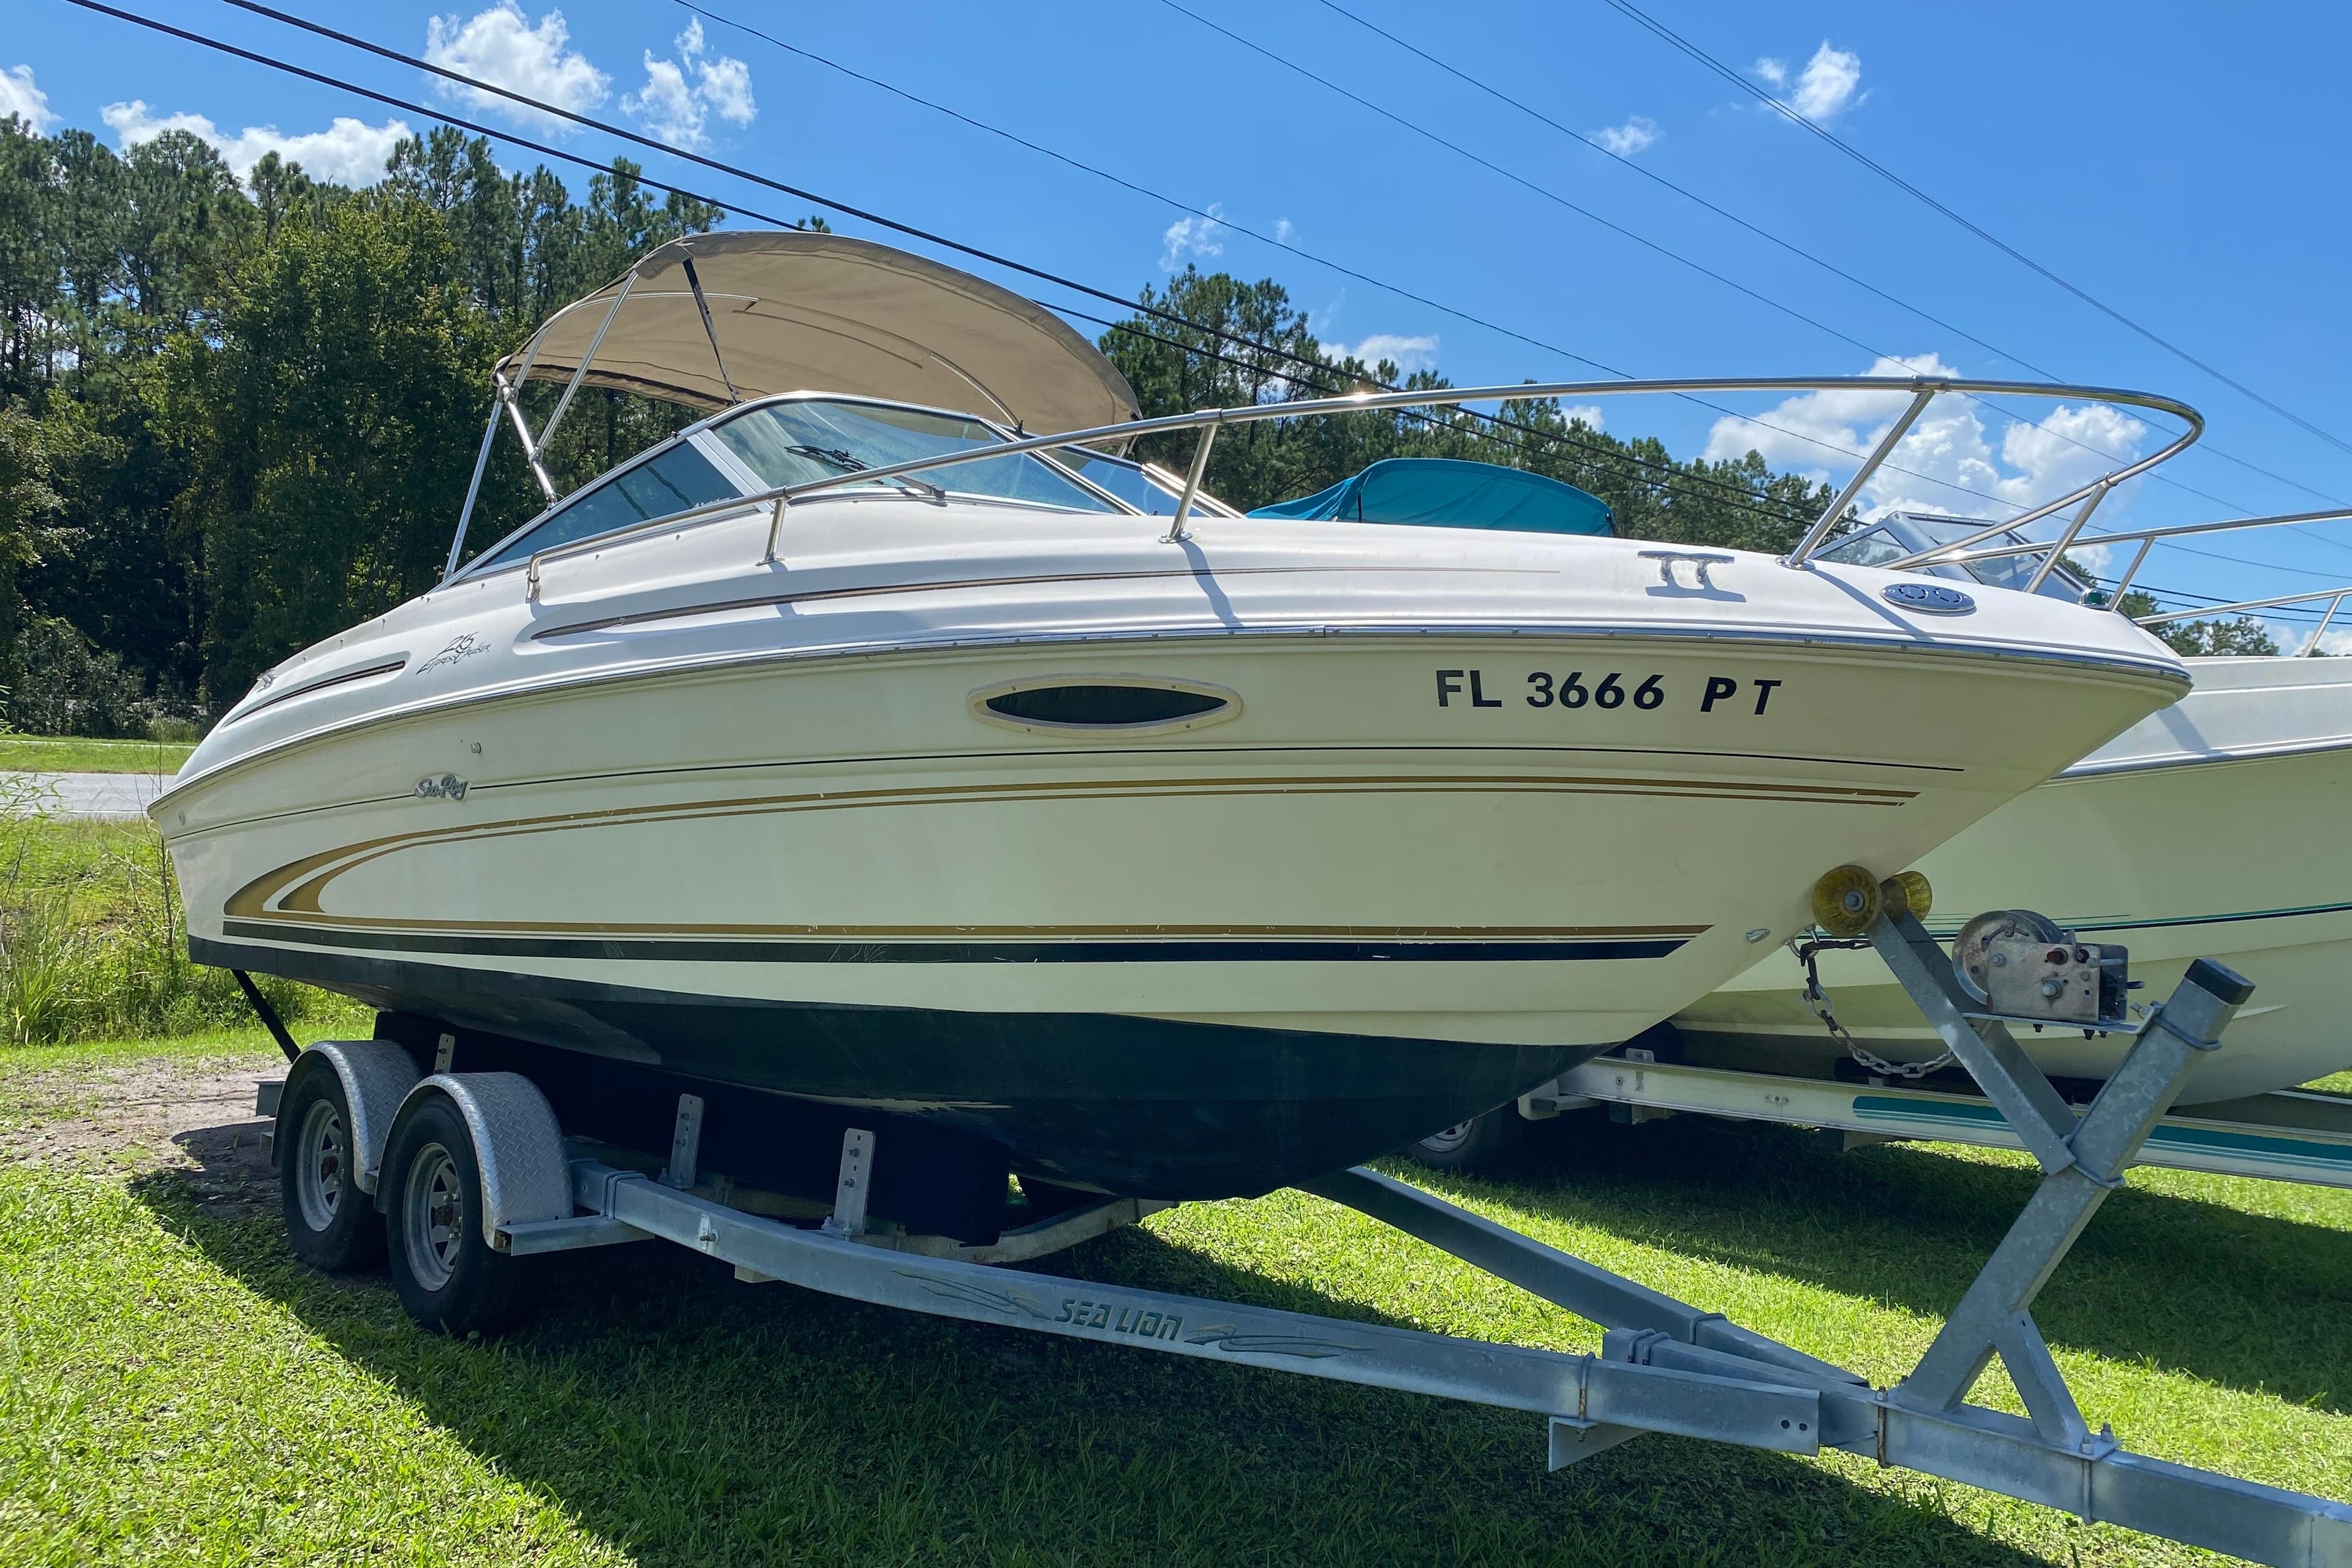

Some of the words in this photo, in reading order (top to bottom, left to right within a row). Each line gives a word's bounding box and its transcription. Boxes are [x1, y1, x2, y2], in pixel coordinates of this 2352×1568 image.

[1436, 669, 1502, 707] FL
[1526, 671, 1665, 710] 3666
[1054, 1298, 1112, 1330] SEA
[1114, 1307, 1183, 1341] LION
